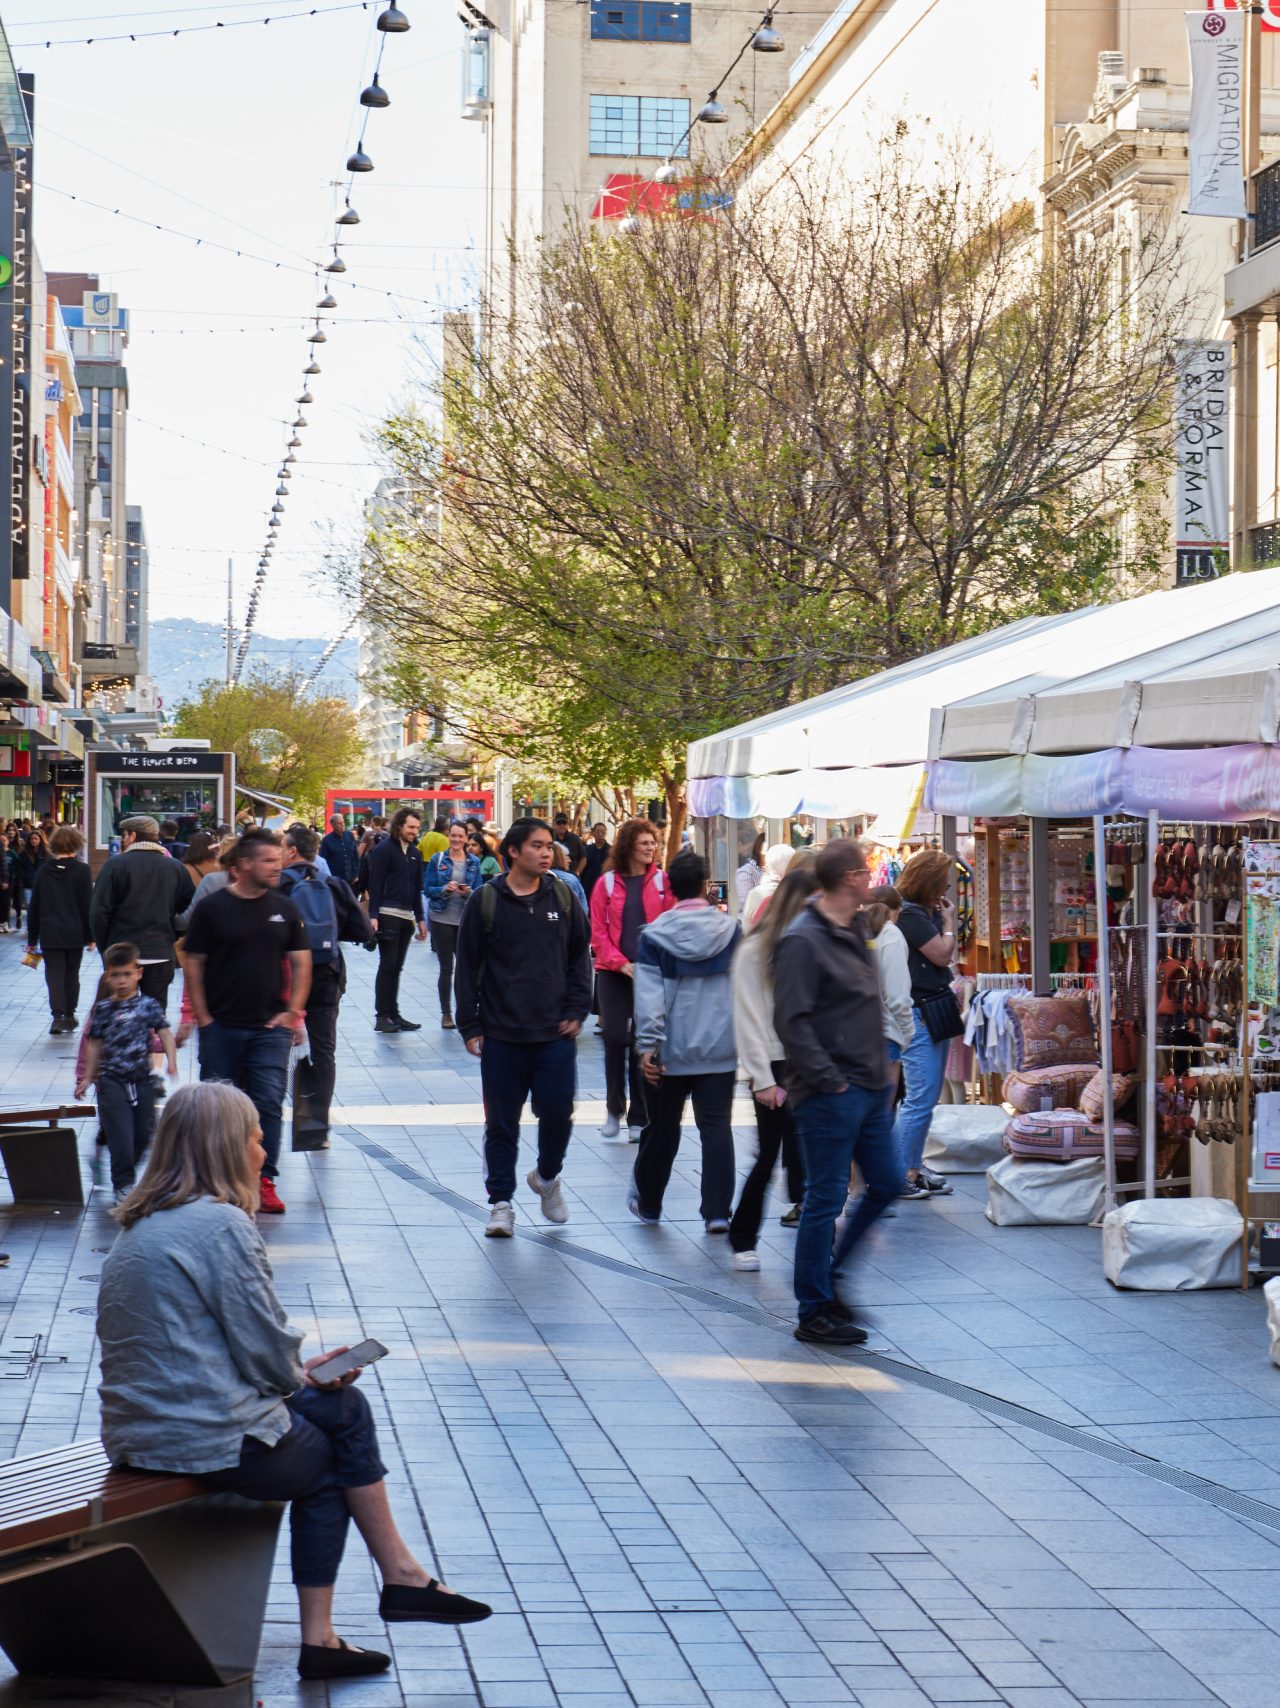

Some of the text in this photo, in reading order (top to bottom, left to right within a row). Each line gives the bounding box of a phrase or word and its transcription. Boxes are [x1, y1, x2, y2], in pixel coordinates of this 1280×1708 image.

[1216, 44, 1240, 167] MIGRATION
[1185, 373, 1203, 533] & FORMAL
[1206, 350, 1224, 457] BRIDAL
[12, 389, 24, 545] ADELAIDE
[122, 757, 198, 767] THE FLOWER DEPO
